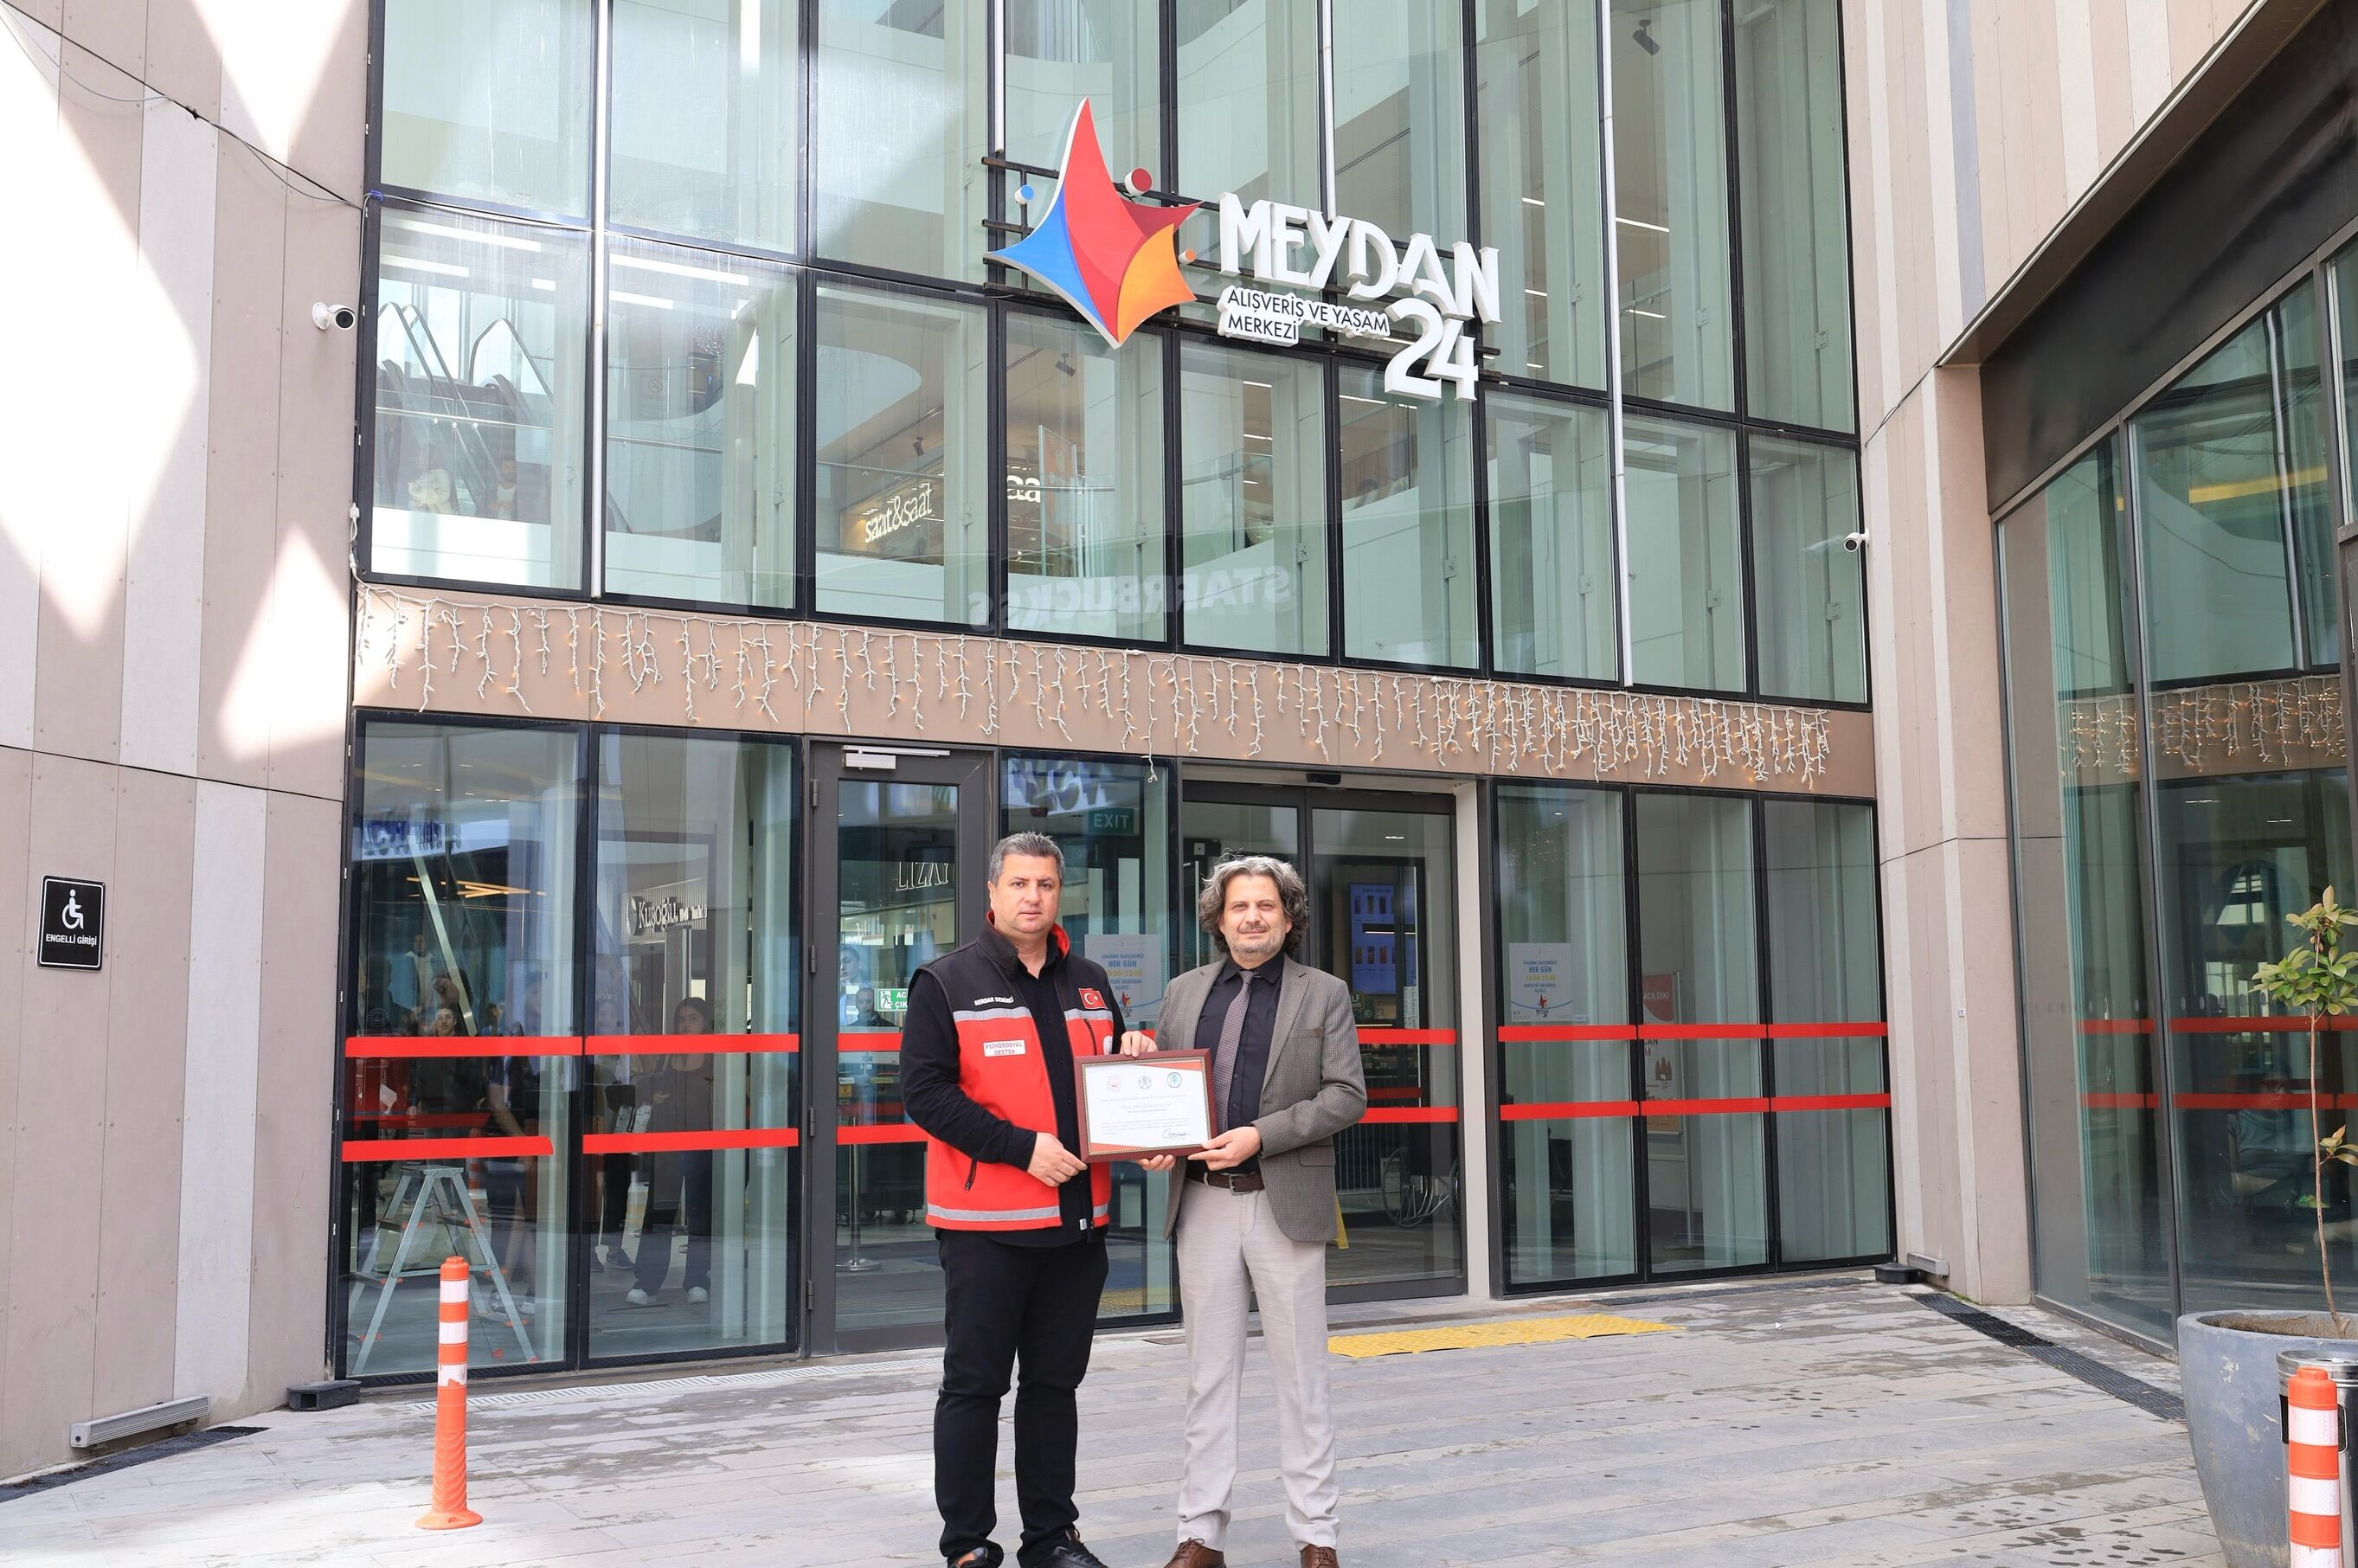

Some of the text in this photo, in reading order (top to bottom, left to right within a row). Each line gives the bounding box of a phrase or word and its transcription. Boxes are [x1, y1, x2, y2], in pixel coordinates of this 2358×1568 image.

[1218, 190, 1501, 325] MEYDAN
[1227, 289, 1391, 332] ALIŞVERİŞ VE YAŞAM
[1228, 313, 1297, 340] MERKEZİ
[1384, 297, 1478, 402] 24
[865, 482, 933, 543] saat&saat
[1093, 813, 1130, 829] EXIT
[45, 933, 97, 948] ENGELLİ GİRİŞİ
[1122, 959, 1136, 967] GÜN
[895, 1001, 908, 1010] ÇIK
[1643, 991, 1669, 1001] AÇILDIK!
